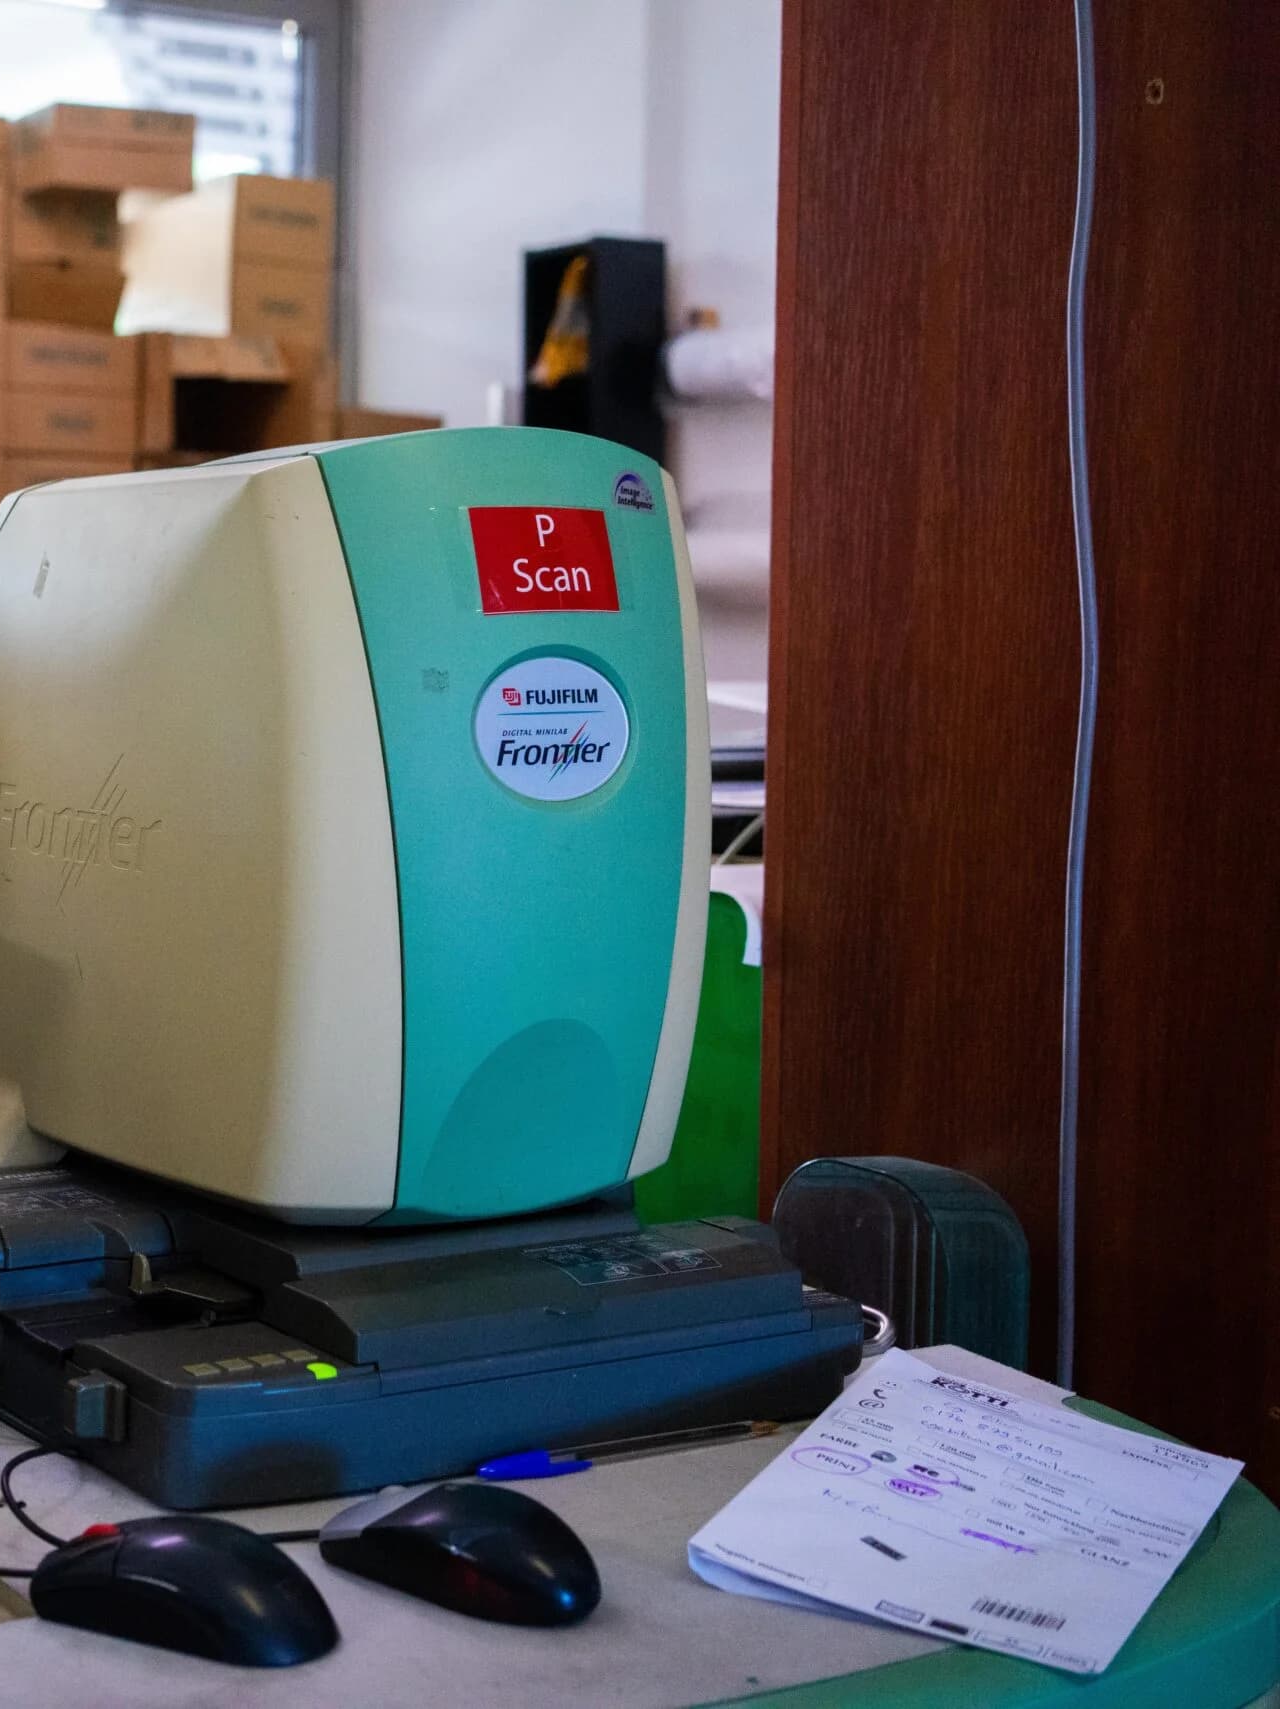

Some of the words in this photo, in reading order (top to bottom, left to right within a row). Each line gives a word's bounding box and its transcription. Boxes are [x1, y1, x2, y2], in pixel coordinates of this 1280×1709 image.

[534, 513, 555, 547] P
[512, 557, 592, 593] Scan
[526, 688, 598, 704] FUJIFILM
[502, 729, 533, 737] DIGITAL
[536, 728, 568, 736] MINILAB
[497, 739, 610, 767] Frontier
